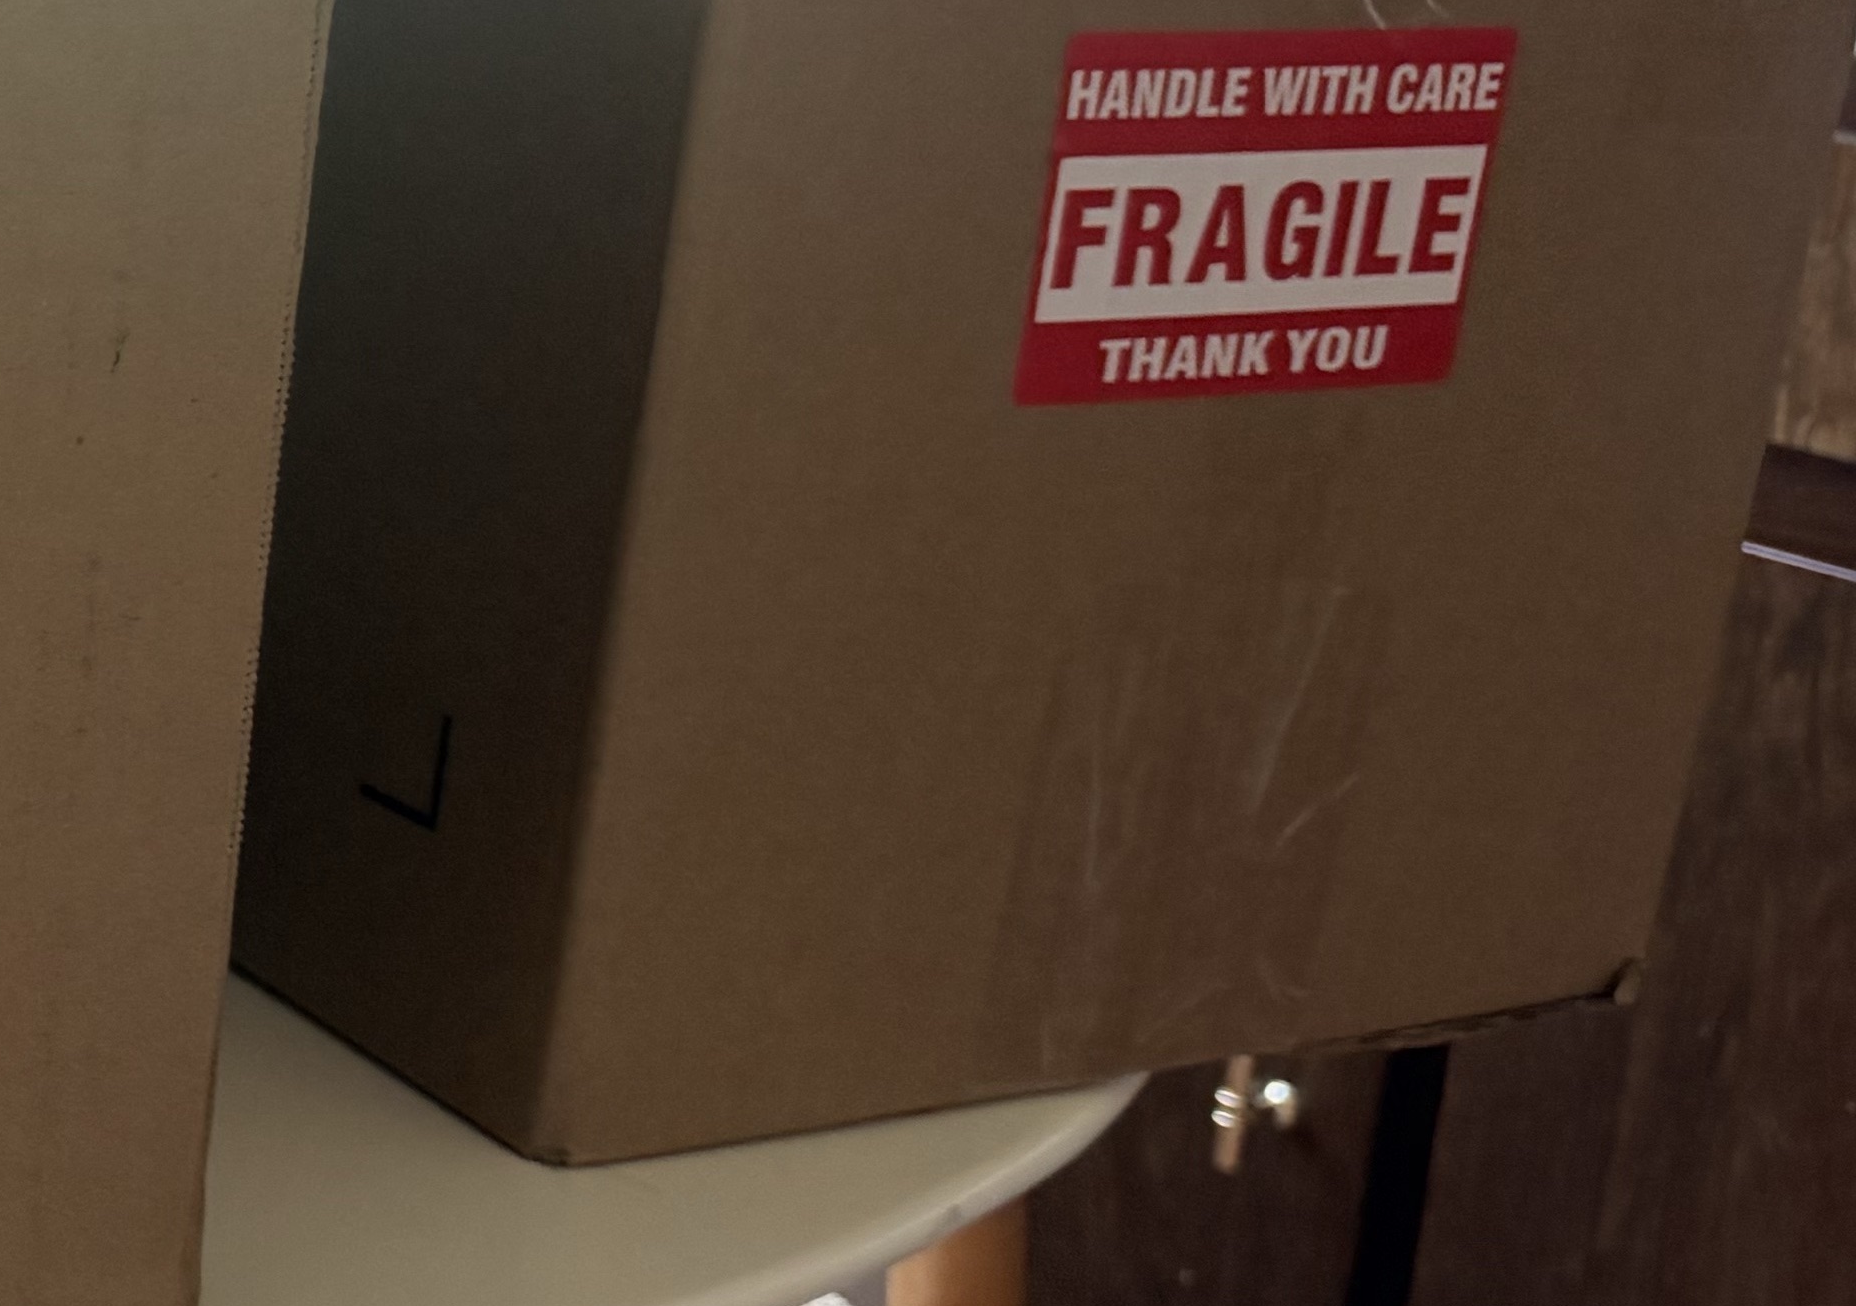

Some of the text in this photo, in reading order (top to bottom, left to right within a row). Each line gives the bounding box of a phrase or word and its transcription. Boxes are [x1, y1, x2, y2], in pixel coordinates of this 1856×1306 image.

[1066, 62, 1505, 120] HANDLE WITH CARE
[1049, 177, 1471, 289] FRAGILE
[1099, 325, 1388, 383] THANK YOU
